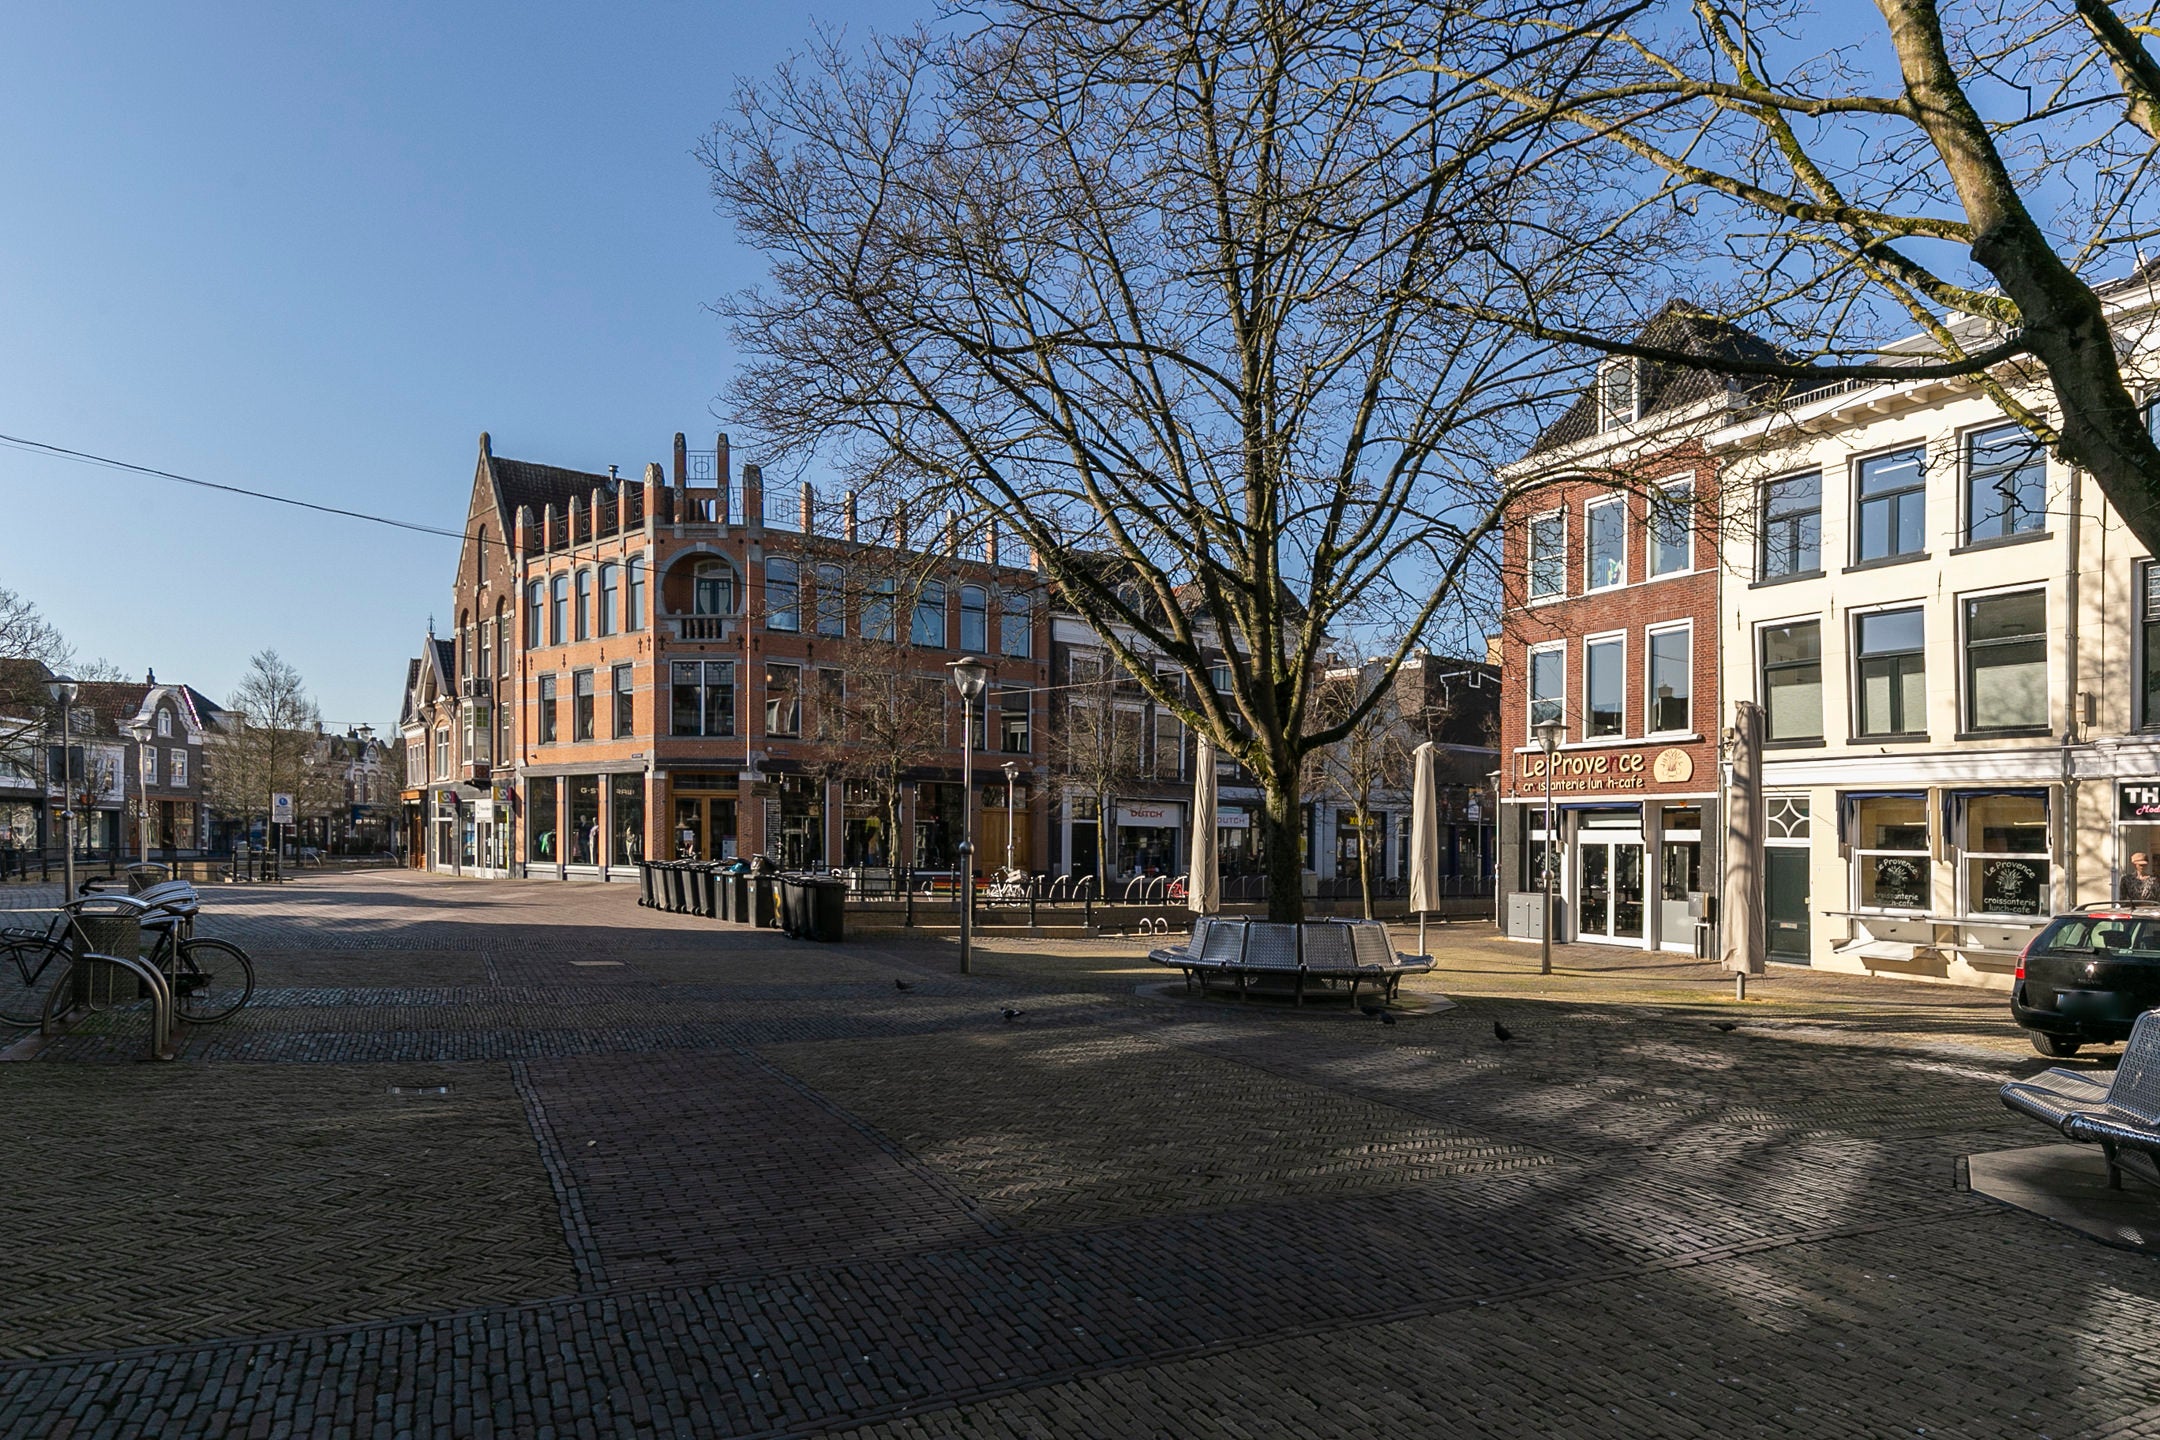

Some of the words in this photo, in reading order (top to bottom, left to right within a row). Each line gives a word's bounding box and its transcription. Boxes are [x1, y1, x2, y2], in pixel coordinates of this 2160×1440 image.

[1523, 753, 1546, 778] Le
[1551, 751, 1644, 776] Provence
[1523, 777, 1585, 792] croisanterie
[1130, 810, 1163, 818] DUTCH
[1216, 816, 1246, 824] DUTCH
[1883, 858, 1918, 875] Provence
[1984, 866, 1996, 877] Le
[1995, 861, 2036, 879] Provence
[1983, 896, 2037, 907] croissanterie
[1988, 903, 2031, 914] lunch-cafe
